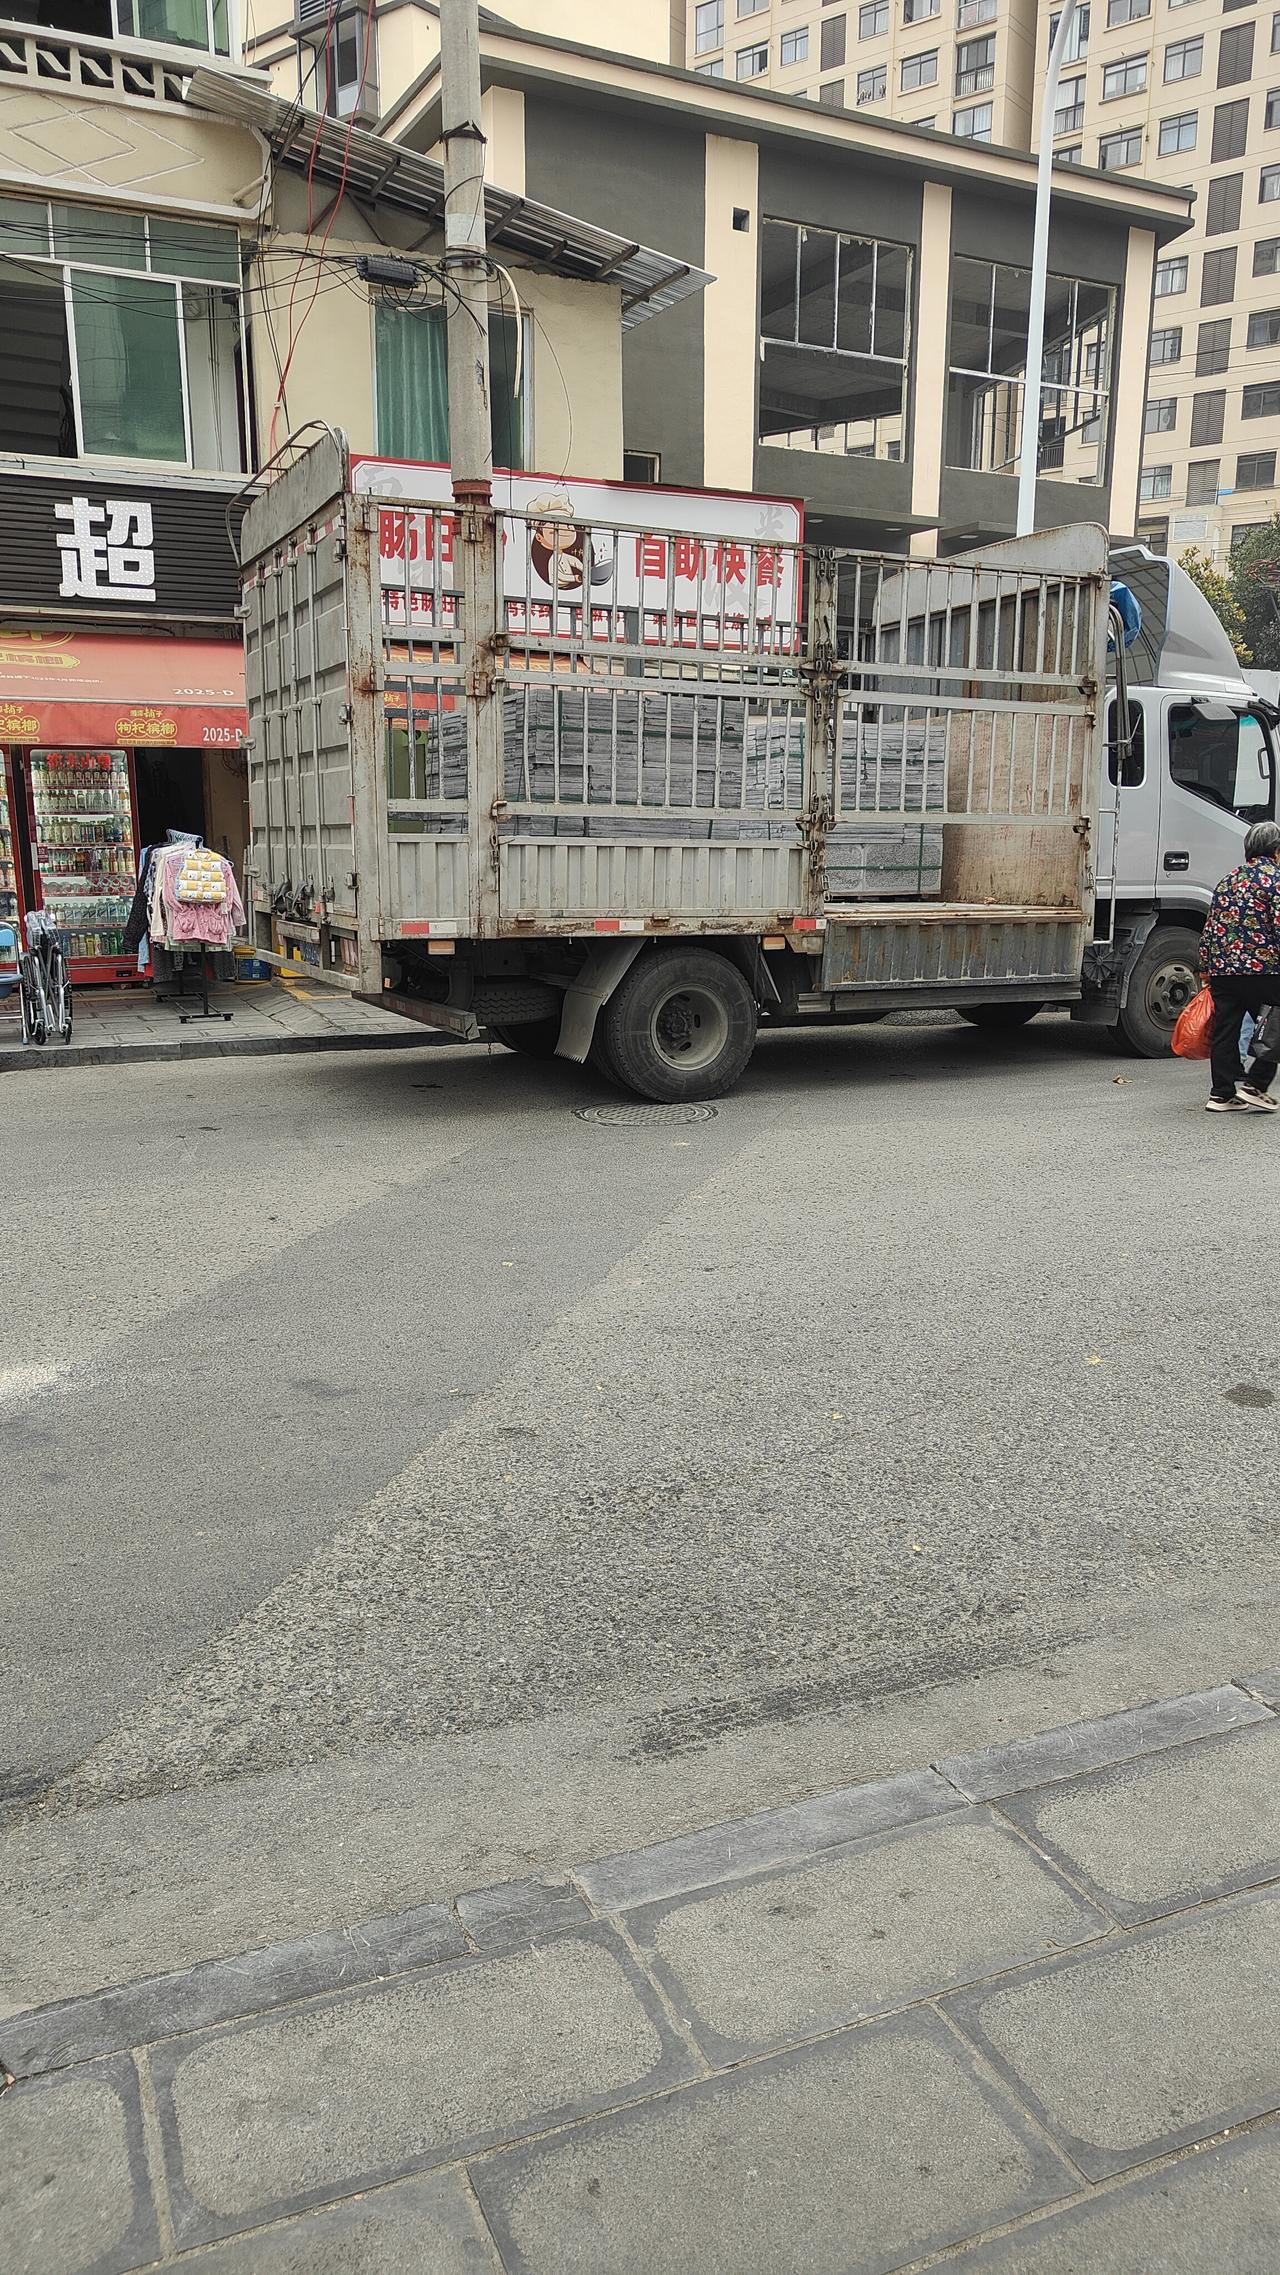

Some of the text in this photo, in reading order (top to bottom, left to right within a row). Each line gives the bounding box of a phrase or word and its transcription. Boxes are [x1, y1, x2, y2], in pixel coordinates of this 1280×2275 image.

[55, 497, 157, 602] 超
[634, 532, 785, 589] 自助快餐
[172, 688, 235, 696] 2025-D
